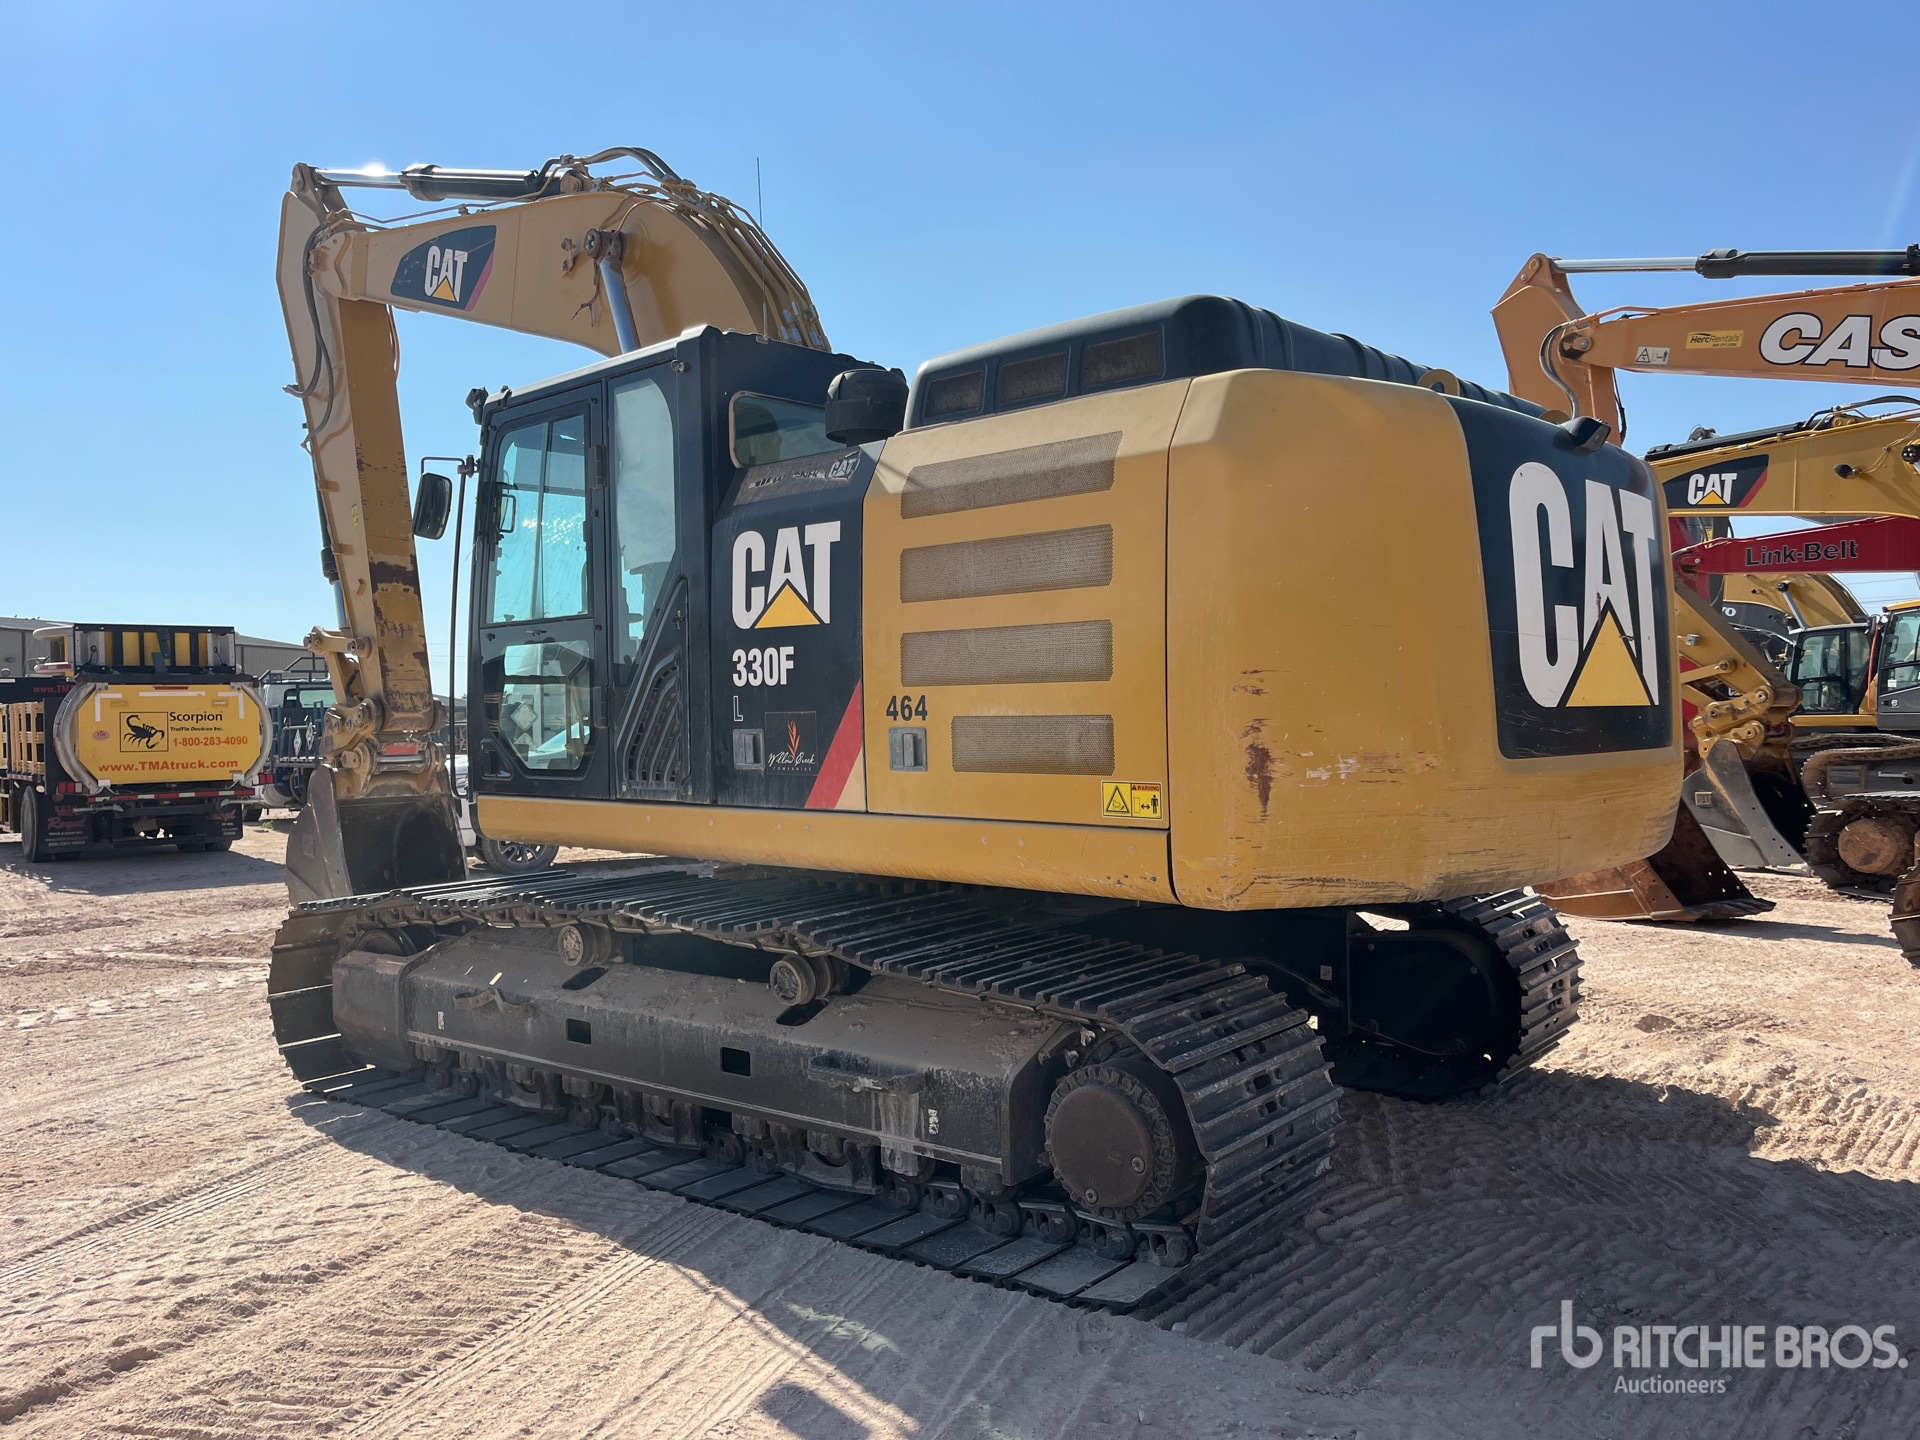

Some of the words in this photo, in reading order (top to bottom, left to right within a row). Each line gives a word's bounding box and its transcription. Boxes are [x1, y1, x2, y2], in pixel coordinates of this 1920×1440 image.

[424, 245, 468, 302] CAT
[828, 458, 857, 478] CAT
[1687, 472, 1738, 505] CAT
[1745, 540, 1858, 566] Link-Belt
[732, 520, 841, 629] CAT
[1509, 462, 1660, 708] CAT
[732, 646, 794, 687] 330F
[33, 685, 75, 693] www.TM
[169, 711, 223, 723] Scorpion
[733, 695, 744, 722] L
[886, 694, 928, 721] 464
[173, 735, 248, 746] 1-800-283-4090
[98, 760, 238, 771] www.TMAtruck.com
